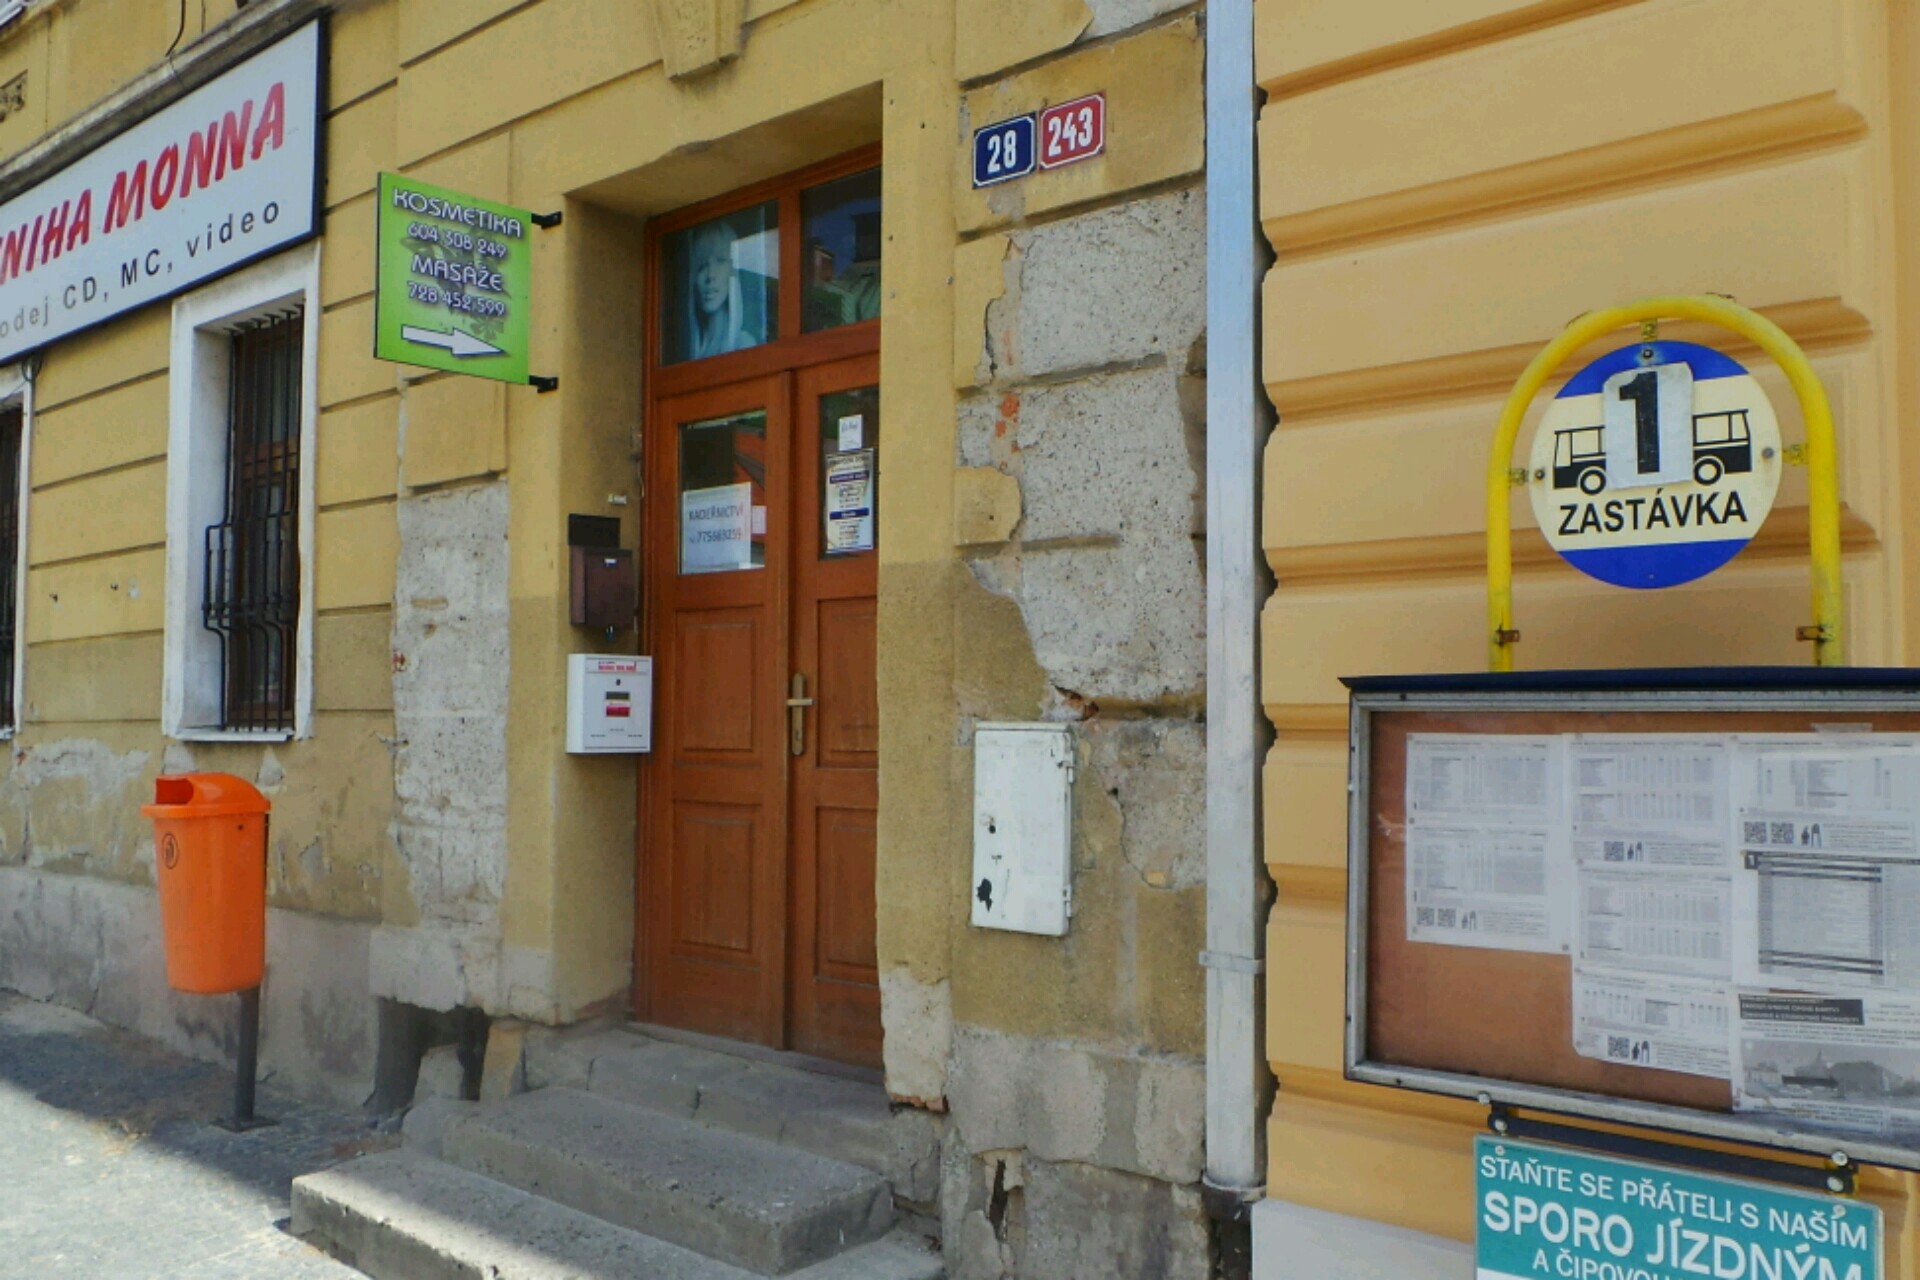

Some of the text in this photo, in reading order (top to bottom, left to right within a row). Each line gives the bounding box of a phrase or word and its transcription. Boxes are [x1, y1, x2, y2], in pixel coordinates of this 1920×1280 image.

[987, 130, 1016, 174] 28
[1048, 107, 1093, 156] 243
[0, 81, 285, 286] NIHA MONNA
[393, 188, 522, 238] KOSMETIKA
[63, 276, 108, 309] CD,
[121, 249, 173, 288] MC,
[187, 202, 279, 258] video
[408, 222, 506, 258] 604 308 249
[412, 255, 503, 291] MASÁŽE
[407, 281, 506, 317] 728 452 599
[1619, 371, 1661, 475] 1
[1558, 488, 1748, 536] ZASTÁVKA
[1481, 1155, 1867, 1250] STAŇTE SE PŘÁTELI S NAŠÍM
[1484, 1191, 1634, 1257] SPORO
[1532, 1248, 1549, 1273] A
